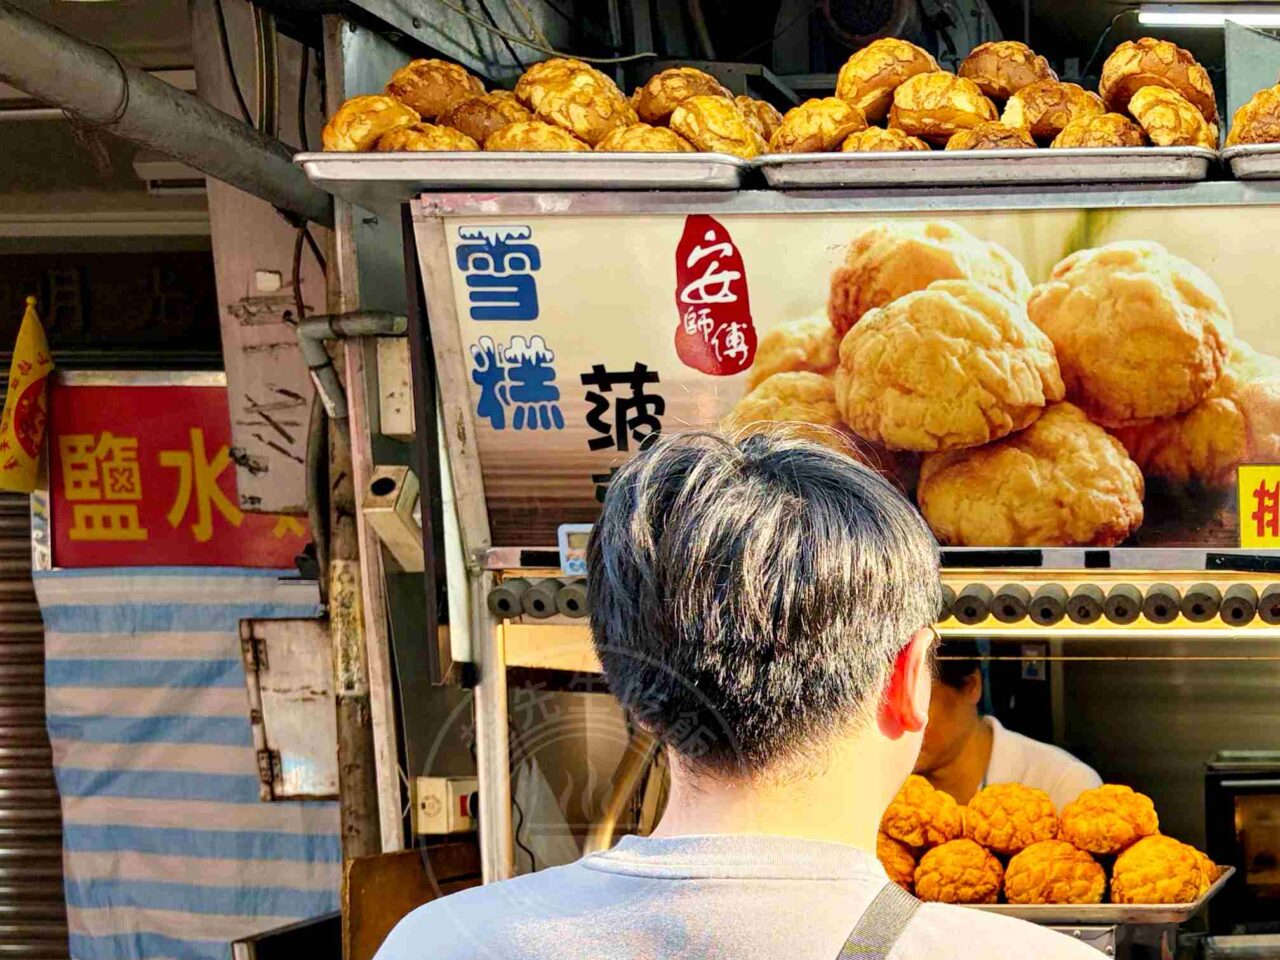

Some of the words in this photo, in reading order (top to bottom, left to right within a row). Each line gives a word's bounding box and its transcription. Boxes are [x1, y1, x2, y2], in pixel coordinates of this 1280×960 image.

[456, 225, 565, 430] 雪糕
[681, 230, 749, 365] 安師傅
[58, 428, 305, 542] 鹽水
